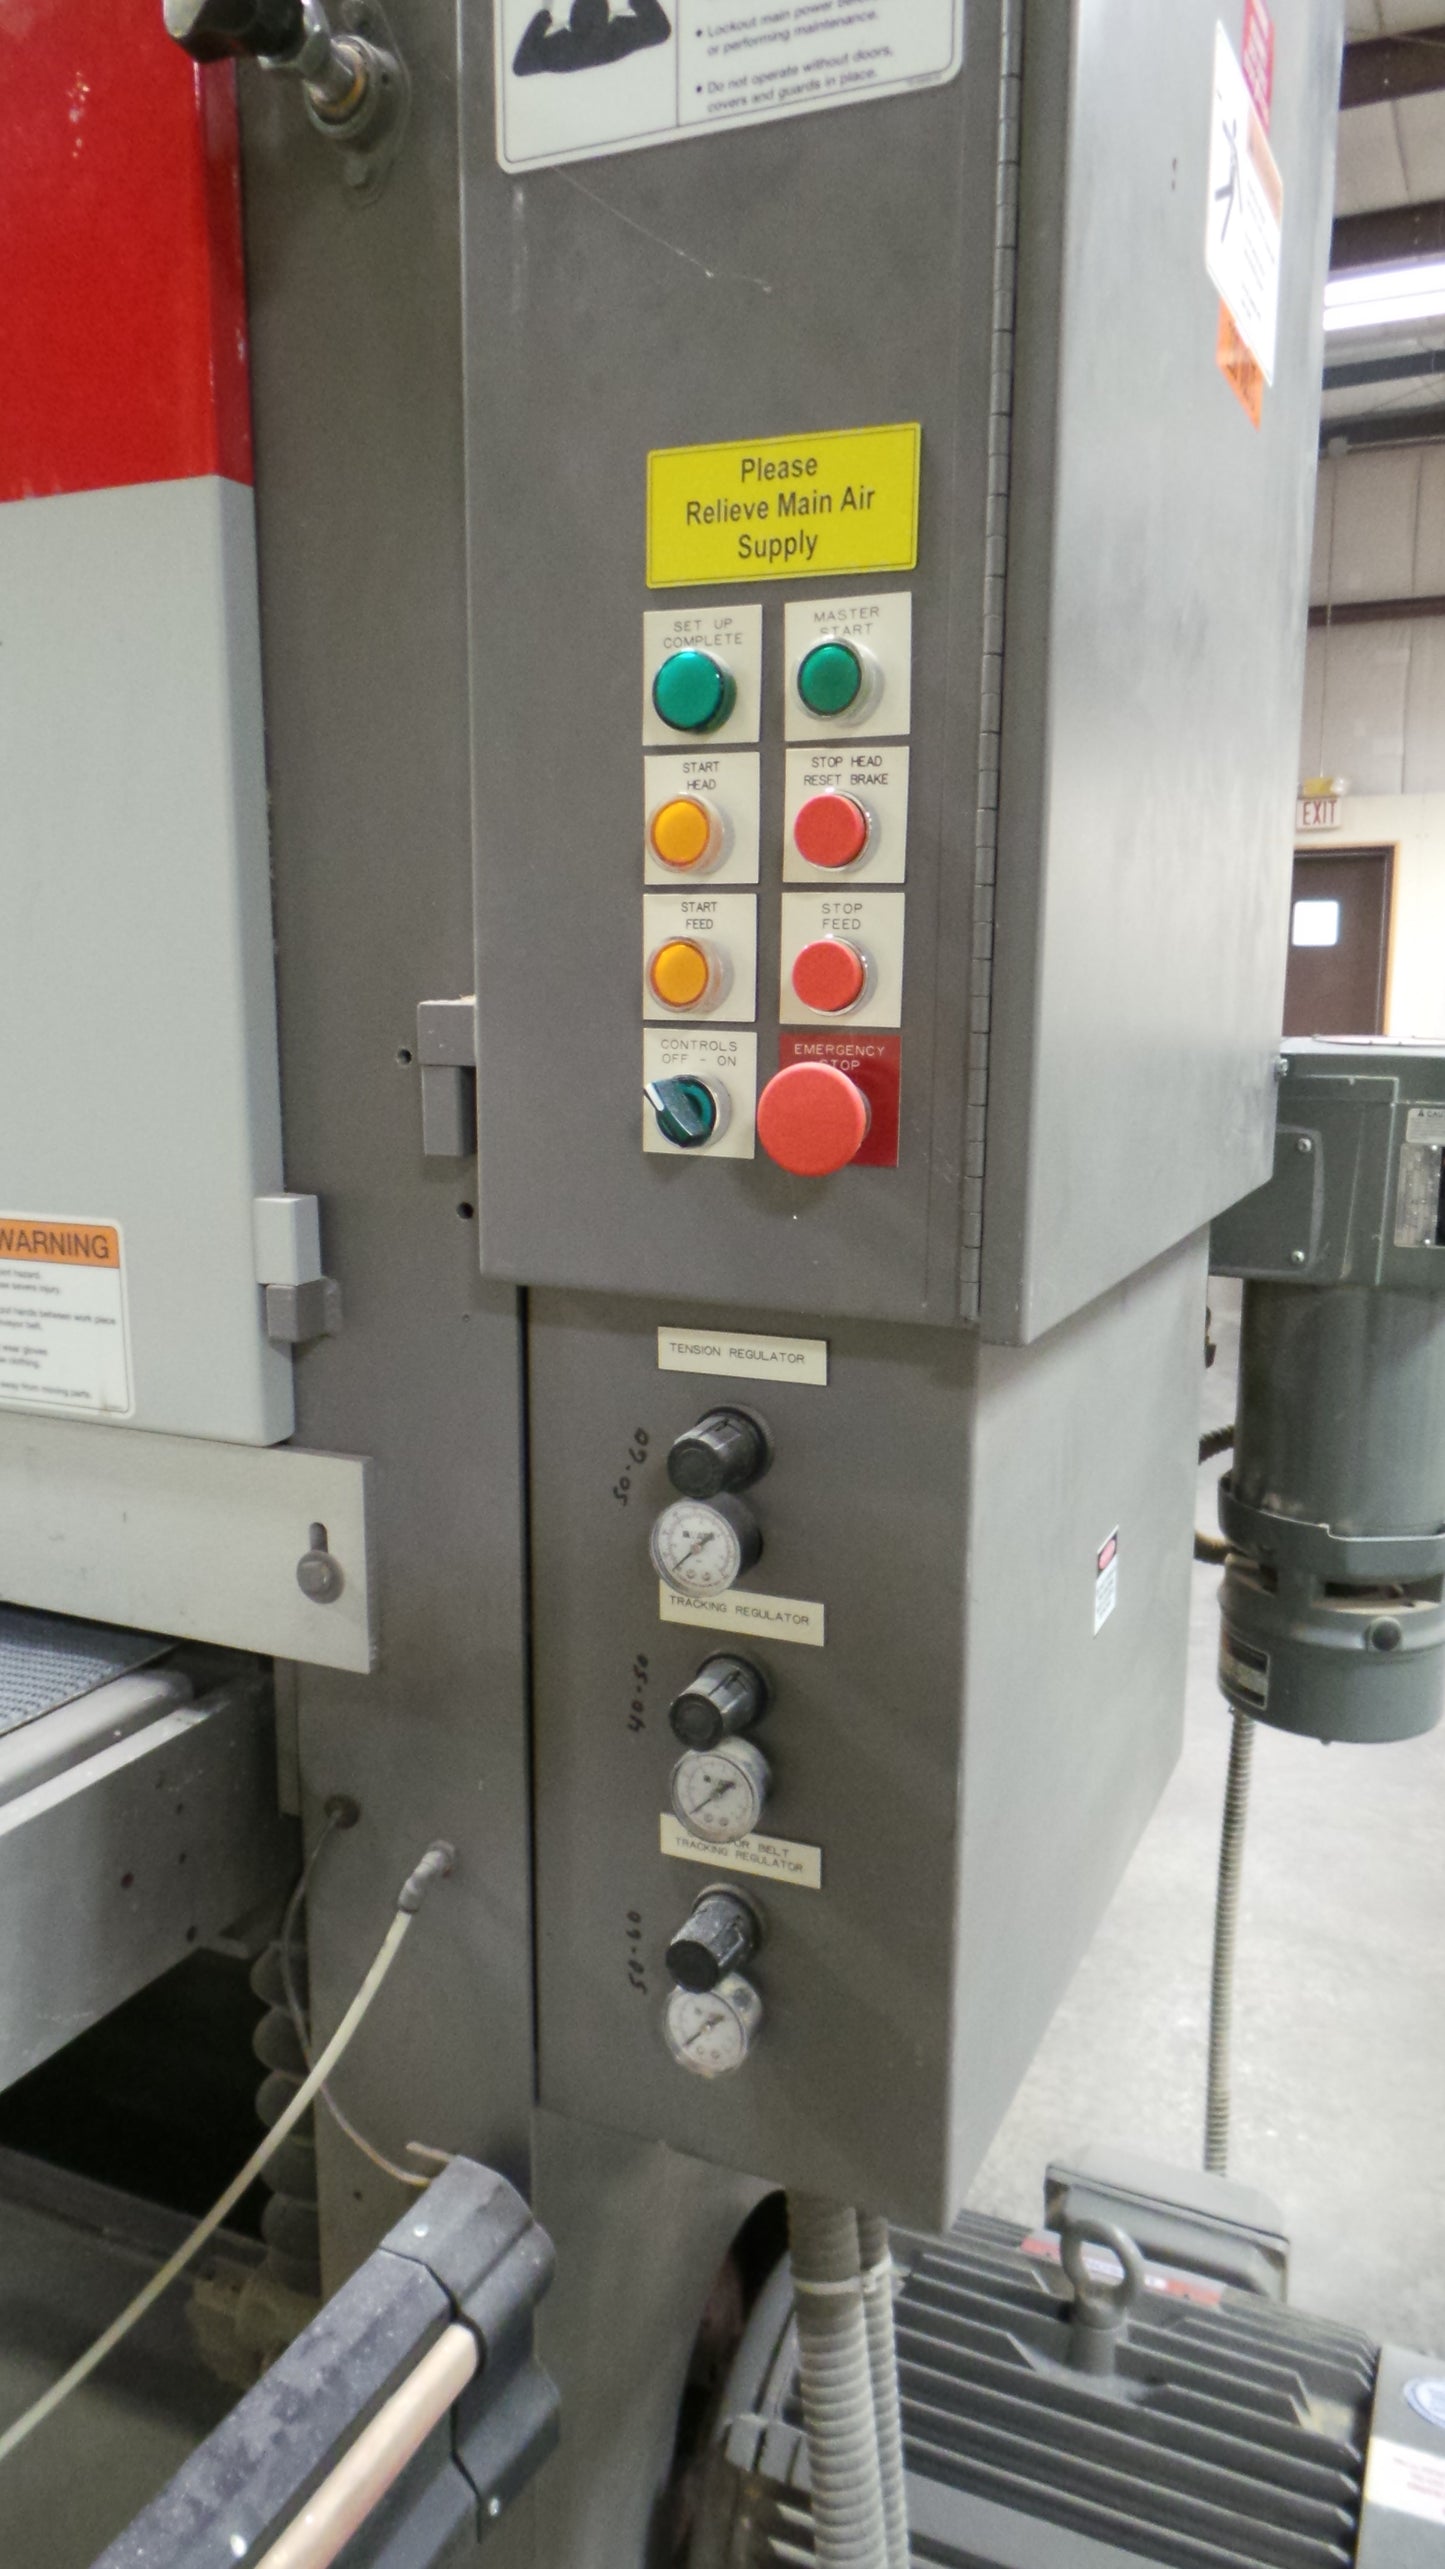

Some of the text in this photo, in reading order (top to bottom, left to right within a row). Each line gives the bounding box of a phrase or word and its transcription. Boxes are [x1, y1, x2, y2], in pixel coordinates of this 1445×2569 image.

[707, 2, 833, 38] Lockout main power
[707, 11, 878, 56] or performing maintenance.
[707, 81, 724, 94] Do
[728, 76, 748, 90] not
[751, 66, 799, 87] operate
[802, 53, 849, 72] without
[707, 67, 878, 113] covers and guards in place.
[740, 456, 818, 483] Please
[685, 485, 876, 526] Relieve Main Air
[737, 529, 818, 563] Supply
[813, 606, 880, 623] MASTER
[673, 617, 733, 633] SET UP
[819, 622, 874, 636] START
[662, 632, 743, 650] COMPLETE
[682, 761, 720, 774] START
[811, 755, 883, 768] STOP HEAD
[687, 779, 717, 791] HEAD
[803, 773, 888, 787] RESET BRAKE
[1302, 800, 1337, 825] EXIT
[680, 901, 718, 913] START
[821, 902, 863, 915] STOP
[685, 918, 714, 930] FEED
[822, 918, 861, 930] FEED
[660, 1038, 738, 1053] CONTROLS
[794, 1043, 885, 1057] EMERGENCY
[662, 1053, 688, 1065] OFF
[717, 1055, 737, 1067] ON
[669, 1342, 806, 1365] TENSION REGULATOR
[669, 1594, 810, 1627] TRACKING REGULATOR
[675, 1836, 805, 1873] TRACKING REGULATOR
[758, 1842, 790, 1858] BELT
